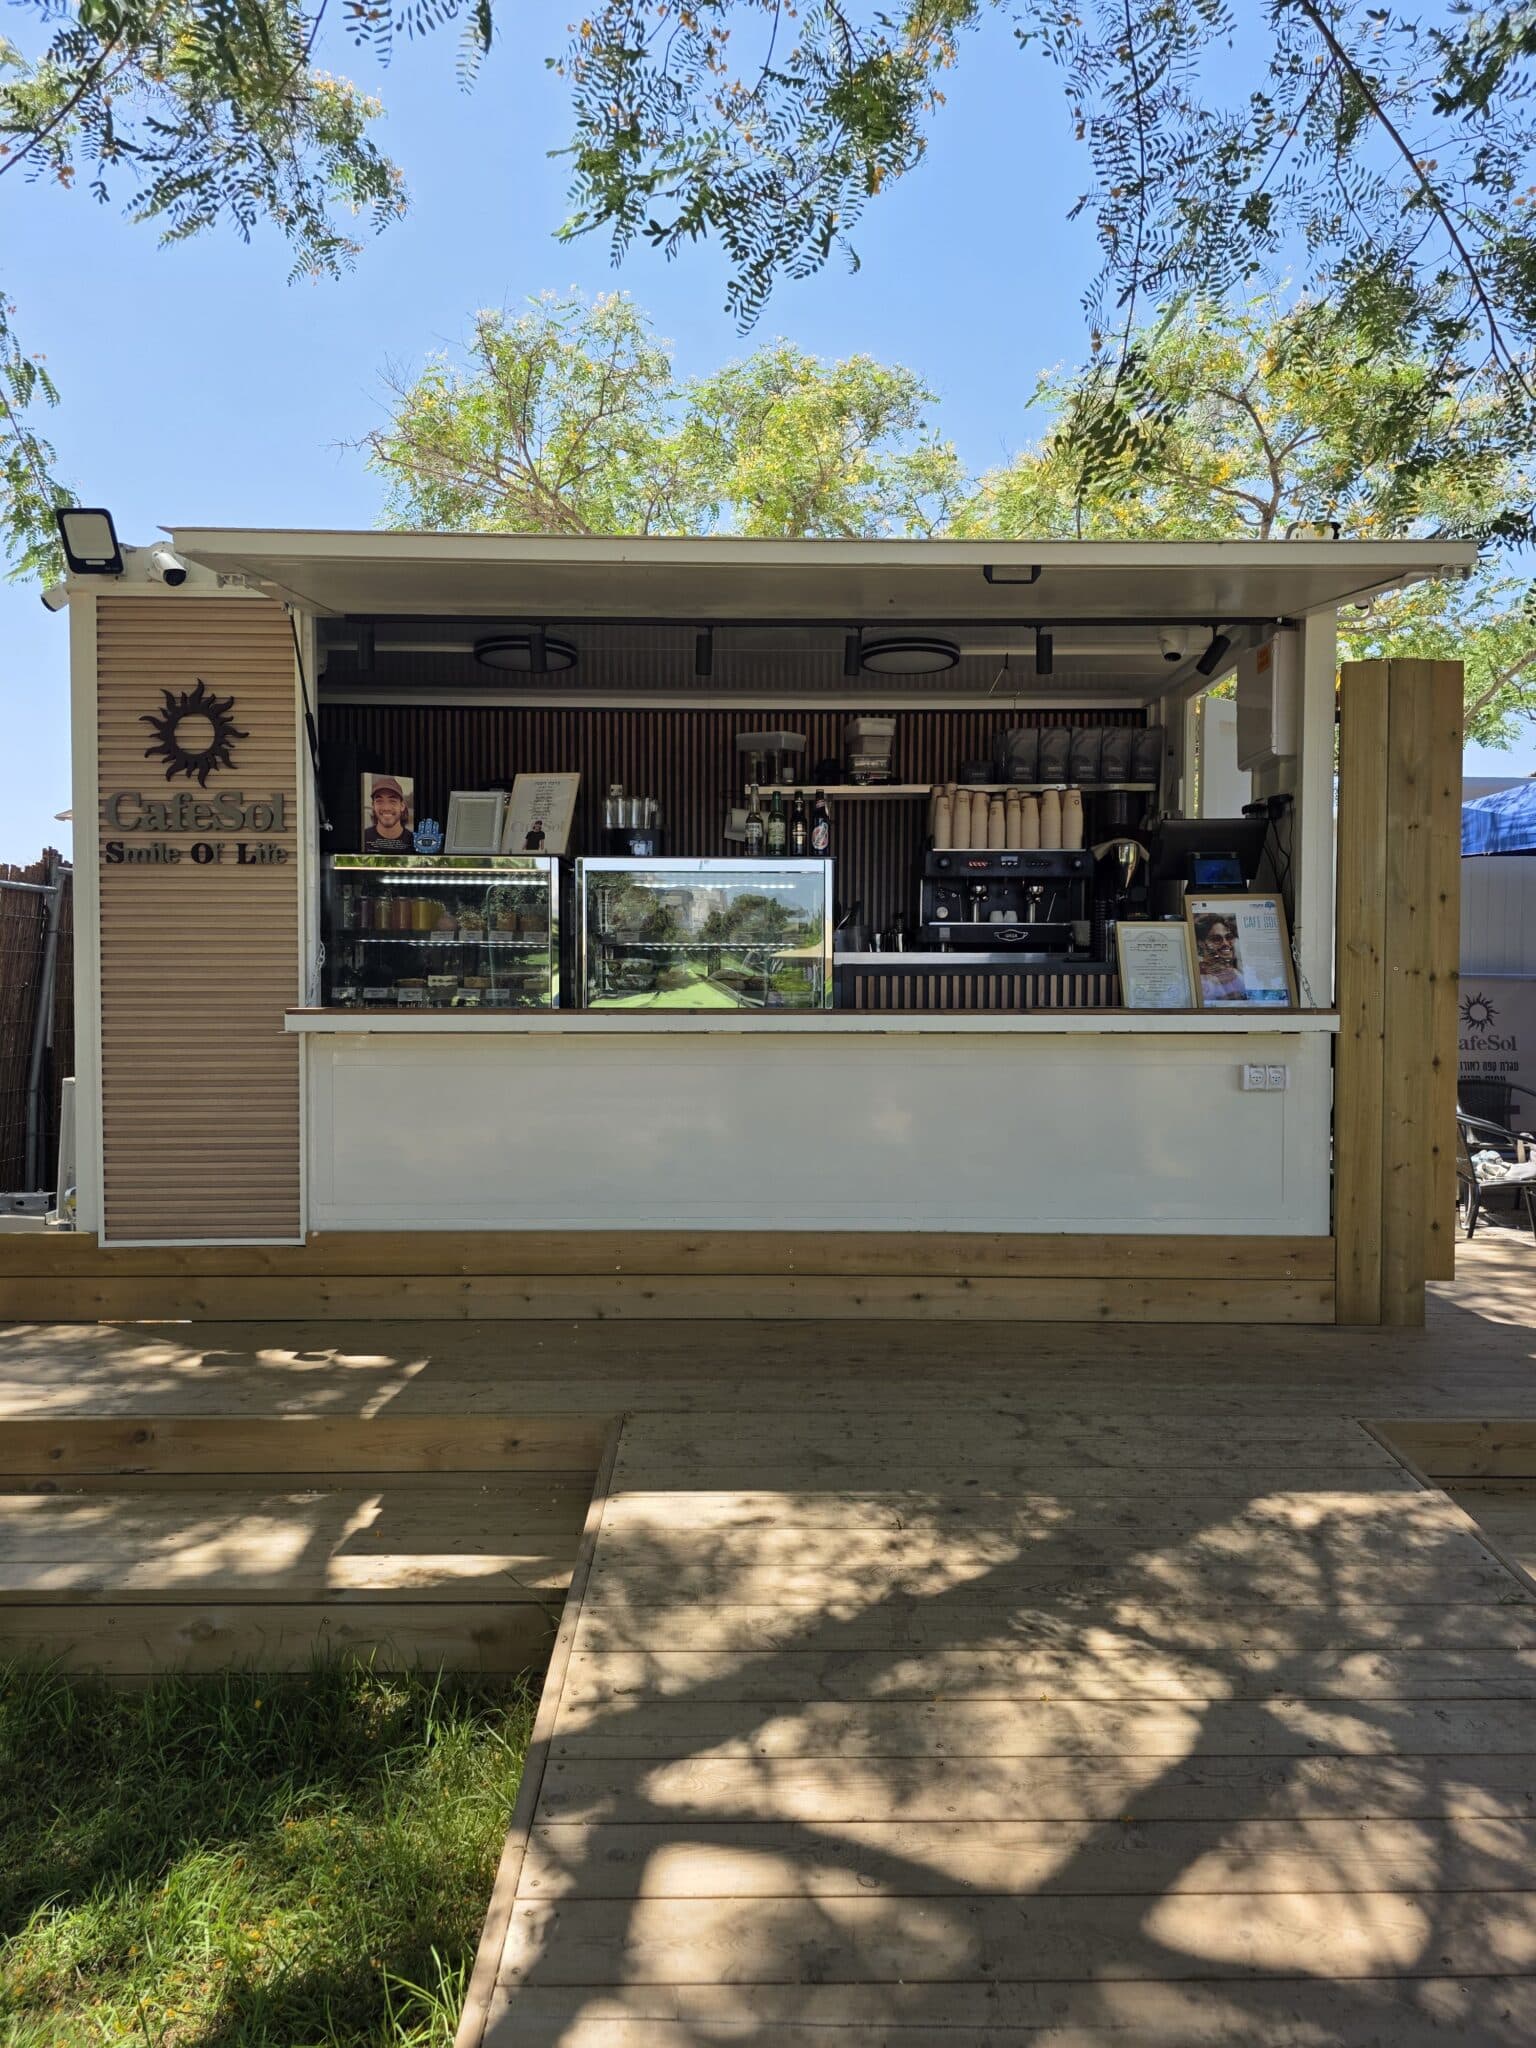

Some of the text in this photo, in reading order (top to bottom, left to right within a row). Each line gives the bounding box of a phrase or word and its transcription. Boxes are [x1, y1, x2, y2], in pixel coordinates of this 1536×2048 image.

[106, 790, 289, 833] CafeSol
[105, 840, 289, 865] Smile Of Life
[1458, 1034, 1518, 1051] afeSol
